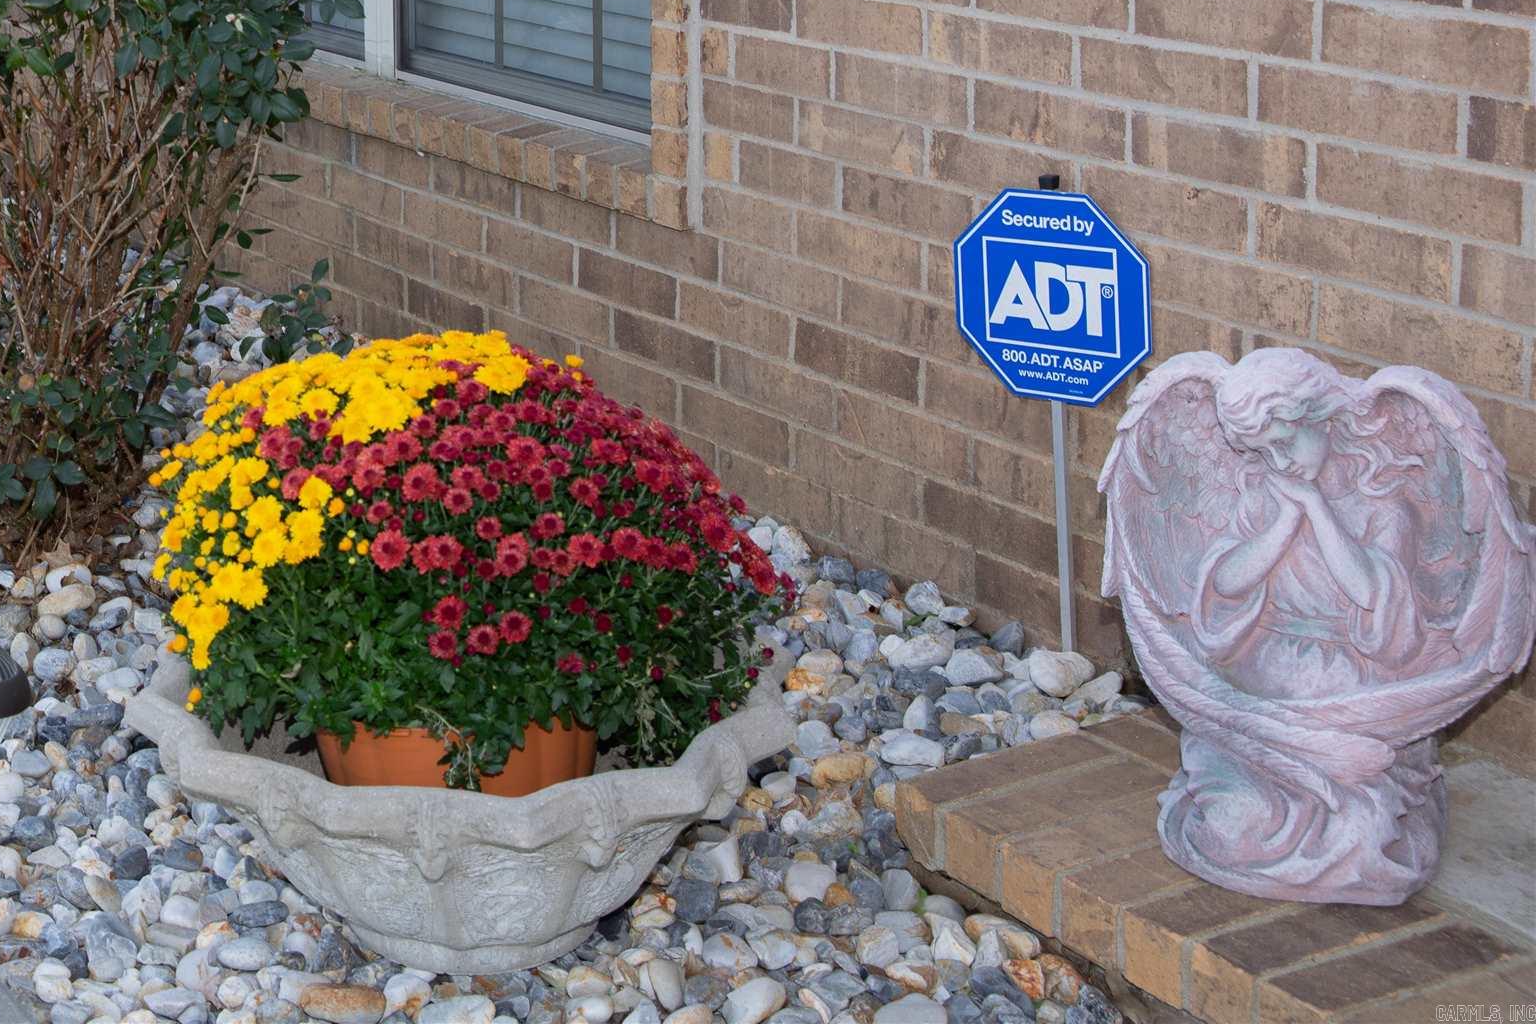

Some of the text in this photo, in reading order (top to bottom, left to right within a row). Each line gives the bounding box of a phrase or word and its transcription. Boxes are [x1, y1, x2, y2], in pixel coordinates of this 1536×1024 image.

[1001, 209, 1094, 236] Secured by
[1002, 348, 1103, 373] 800.ADT.ASAP
[1018, 367, 1089, 386] www.ADT.com
